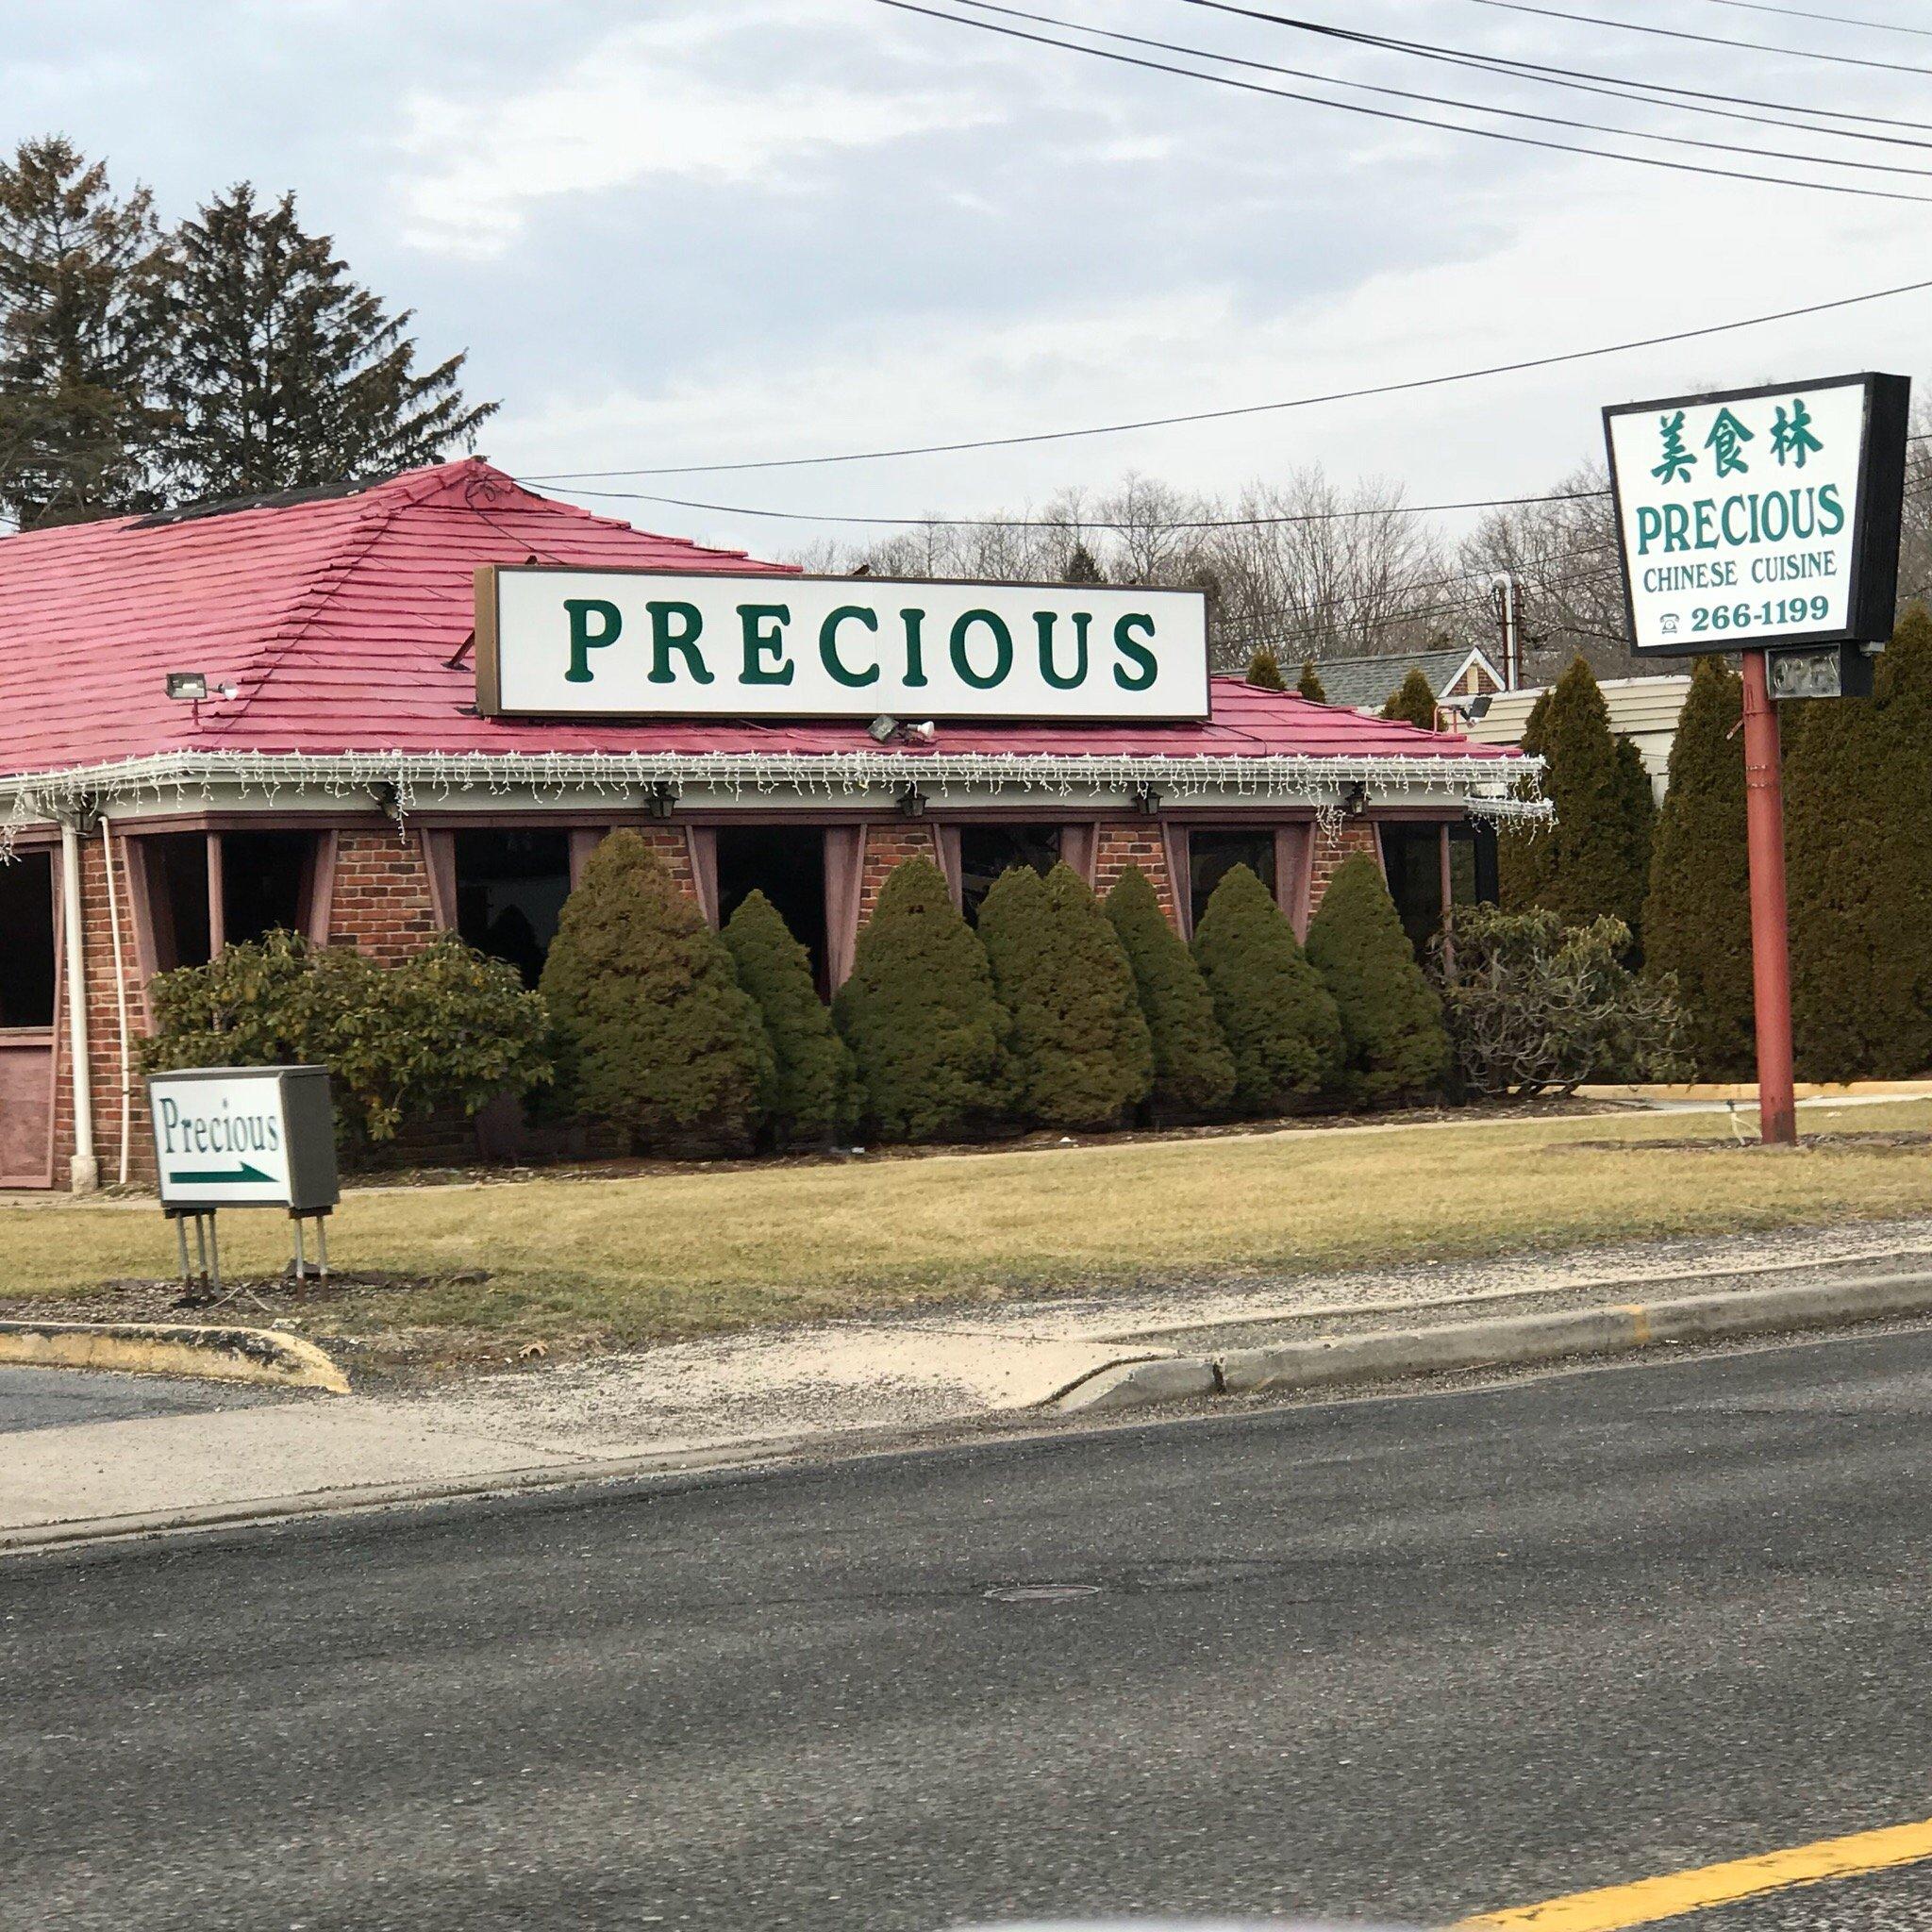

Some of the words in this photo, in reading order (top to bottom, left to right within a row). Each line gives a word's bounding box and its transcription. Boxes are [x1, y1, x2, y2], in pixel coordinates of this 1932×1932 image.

[1651, 398, 1824, 484] 美食林
[1637, 483, 1845, 555] PRECIOUS
[1643, 560, 1738, 593] CHINESE
[1751, 550, 1838, 584] CUISINE
[563, 598, 1158, 691] PRECIOUS
[1691, 595, 1829, 631] 266-1199
[158, 1097, 279, 1154] Precious
